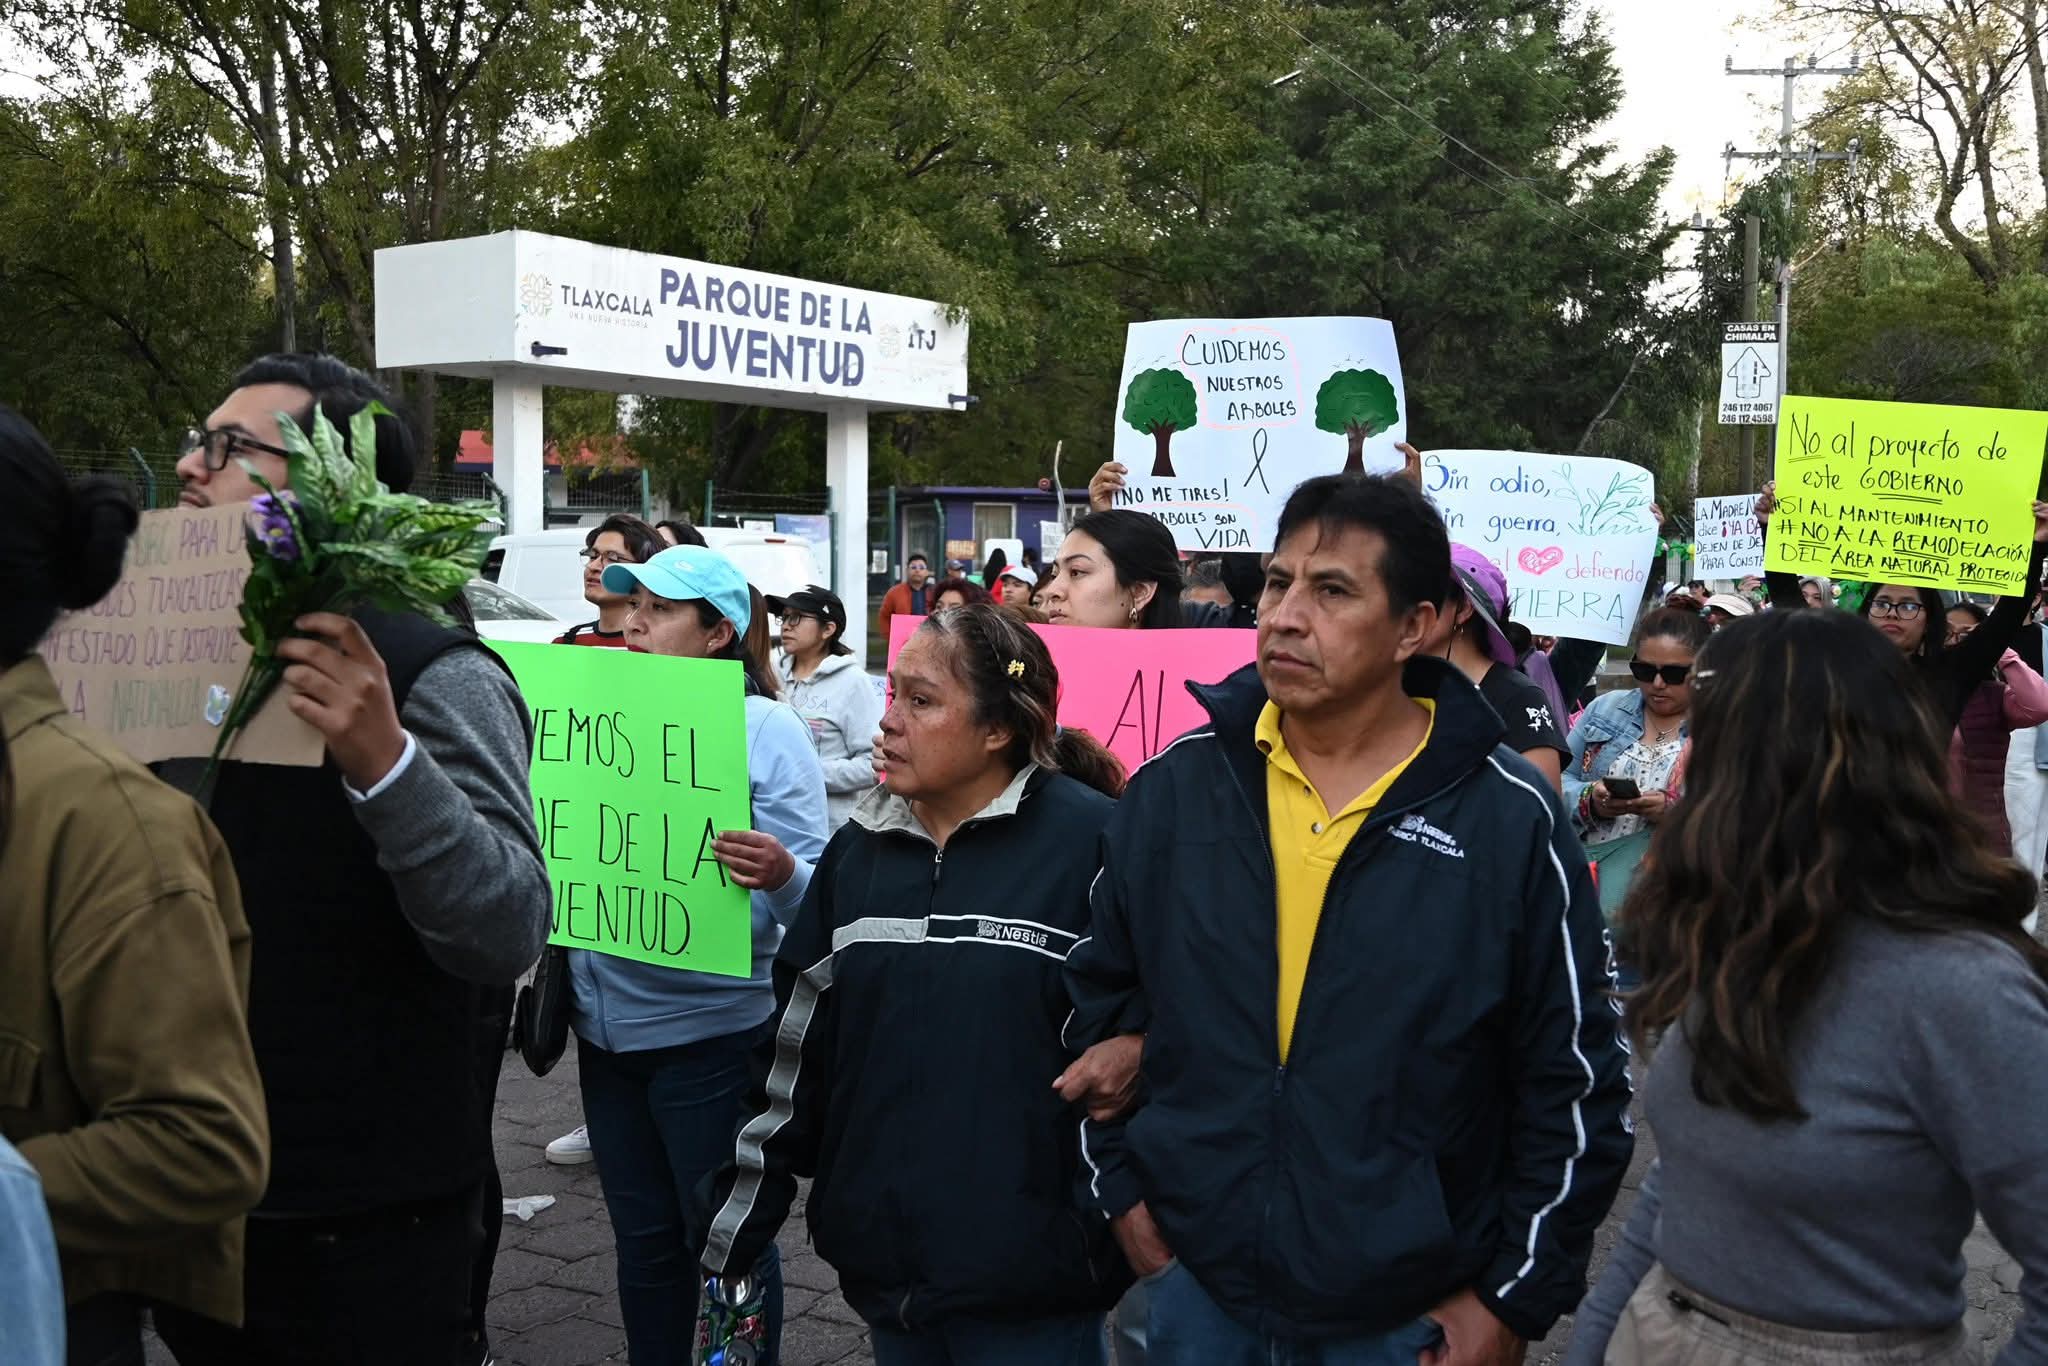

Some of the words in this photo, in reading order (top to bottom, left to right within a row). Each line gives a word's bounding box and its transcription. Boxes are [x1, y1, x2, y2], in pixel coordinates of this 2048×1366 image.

[561, 285, 653, 317] TLAXCALA
[660, 268, 790, 322] PARQUE
[800, 291, 831, 328] DE
[841, 298, 872, 335] LA
[908, 329, 936, 351] ITJ
[1725, 333, 1776, 341] CHIMALPA
[1727, 324, 1759, 332] CASAS
[1761, 324, 1775, 332] EN
[666, 319, 865, 387] JUVENTUD
[1182, 334, 1286, 366] CUIDEMOS
[1207, 375, 1283, 393] NUESTROS
[1228, 400, 1296, 421] ARBOLES
[1721, 414, 1737, 423] 246
[1738, 414, 1750, 423] 112
[1751, 414, 1773, 423] 4598
[1722, 403, 1738, 412] 246
[1739, 403, 1752, 412] 112
[1753, 403, 1773, 412] 4067
[1789, 413, 1820, 455] No
[1831, 421, 1855, 458] al
[1868, 429, 1960, 468] proyecto
[1978, 431, 2008, 460] de
[1424, 454, 1469, 492] Sin
[1490, 465, 1552, 497] odio,
[1802, 464, 1843, 490] este
[1860, 467, 1964, 496] GOBIERNO
[1152, 486, 1172, 502] ME
[1178, 478, 1230, 502] TIRES!
[1215, 513, 1236, 526] SON
[1696, 500, 1708, 521] LA
[1711, 499, 1744, 520] MADRE
[1810, 500, 1833, 518] AL
[1839, 505, 1989, 535] MANTENIMIENTO
[1442, 508, 1464, 528] in
[1484, 515, 1561, 542] guerra,
[1698, 523, 1718, 537] dice
[1833, 525, 1854, 542] A
[1859, 528, 1887, 547] LA
[180, 518, 219, 560] PARA
[1195, 528, 1251, 549] VIDA
[1696, 540, 1728, 554] DEJEN
[1733, 539, 1744, 550] DE
[1566, 550, 1645, 583] defiendo
[1700, 554, 1725, 570] PARA
[1780, 543, 1823, 562] DEL
[1881, 558, 1954, 578] NATURAL
[1510, 587, 1625, 629] TIERRA
[68, 628, 137, 666] ESTADO
[144, 625, 176, 669] QUE
[663, 723, 721, 792] EL
[599, 802, 640, 873] DE
[663, 813, 726, 888] LA
[1421, 836, 1464, 858] TLAXCALA
[1002, 925, 1049, 947] Nestlé
